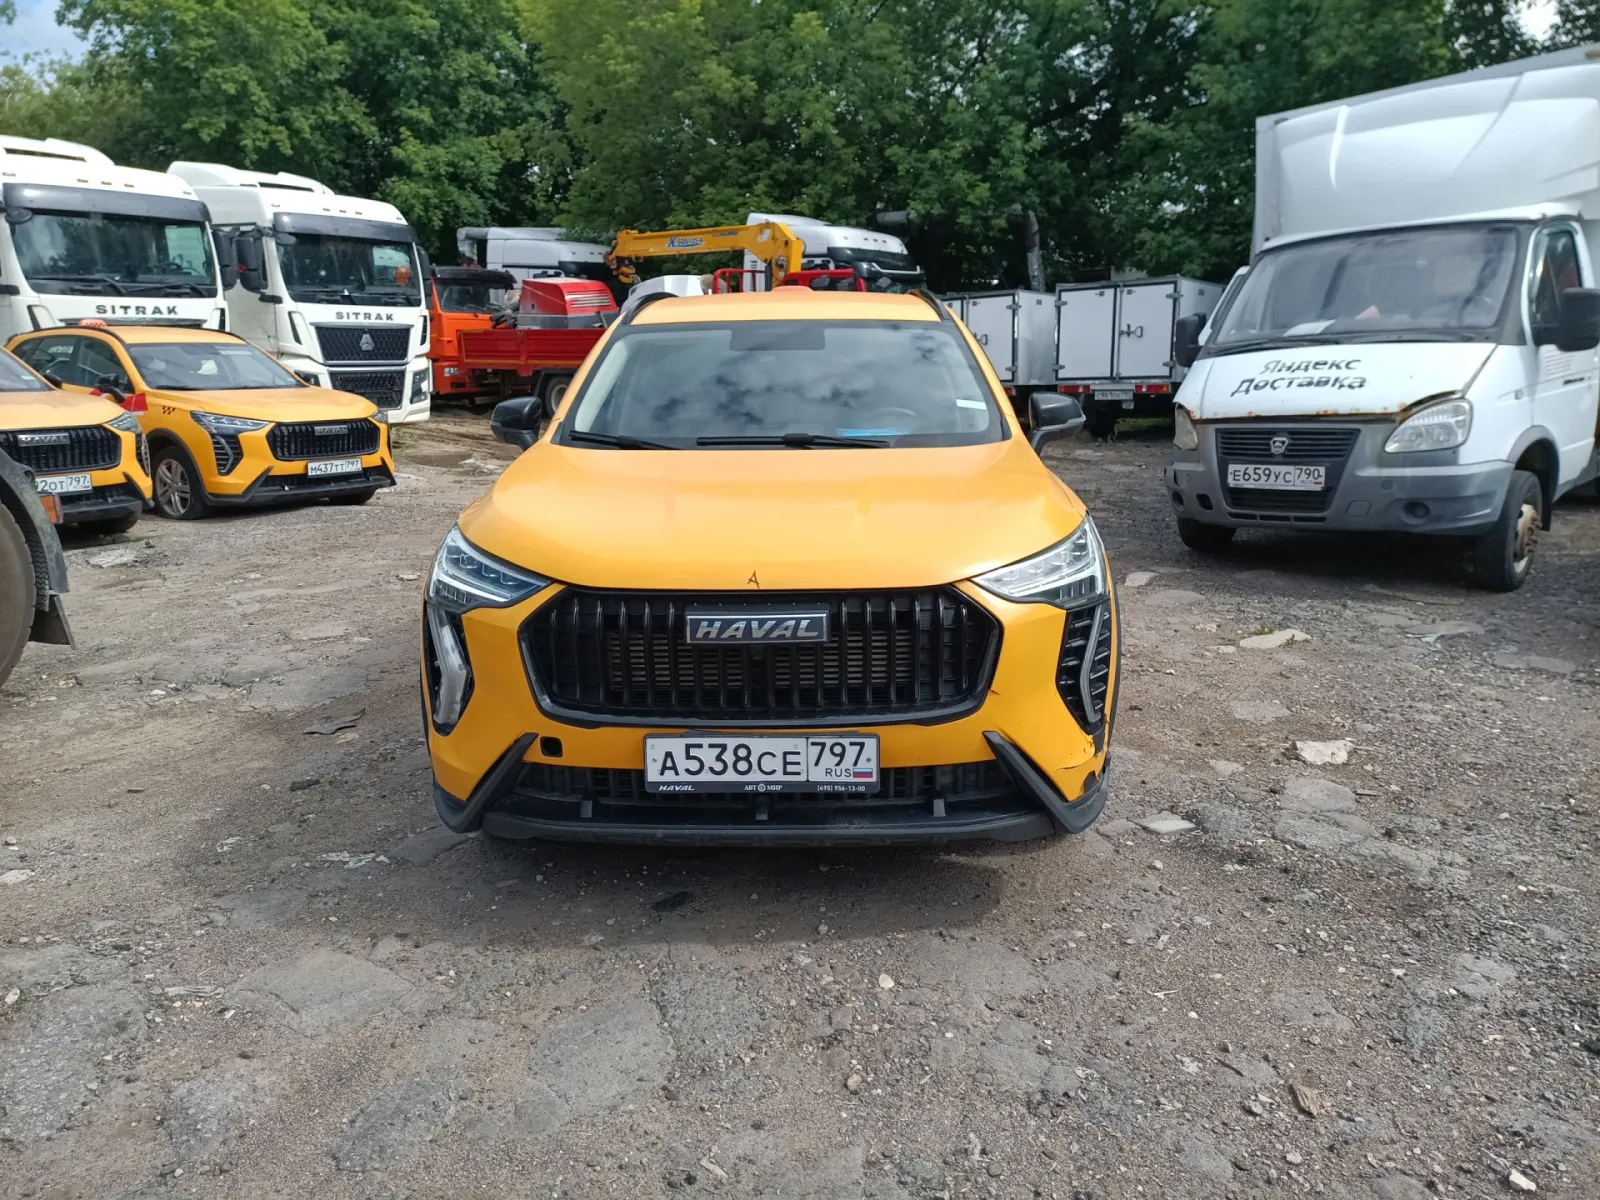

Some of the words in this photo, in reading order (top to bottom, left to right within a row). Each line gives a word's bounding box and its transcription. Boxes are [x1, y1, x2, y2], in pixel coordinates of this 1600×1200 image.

[95, 304, 178, 315] SITRAK
[335, 311, 394, 321] SITRAK
[1259, 359, 1361, 375] Яндекс
[1230, 376, 1367, 397] Доставка
[310, 462, 345, 474] М437ТТ
[346, 459, 359, 468] 797
[67, 475, 87, 486] 797
[1232, 467, 1292, 483] Е659УС
[1296, 467, 1320, 480] 790
[695, 619, 819, 638] HAVAL
[659, 743, 801, 776] А538СЕ
[810, 741, 866, 767] 797
[825, 768, 851, 778] RUS
